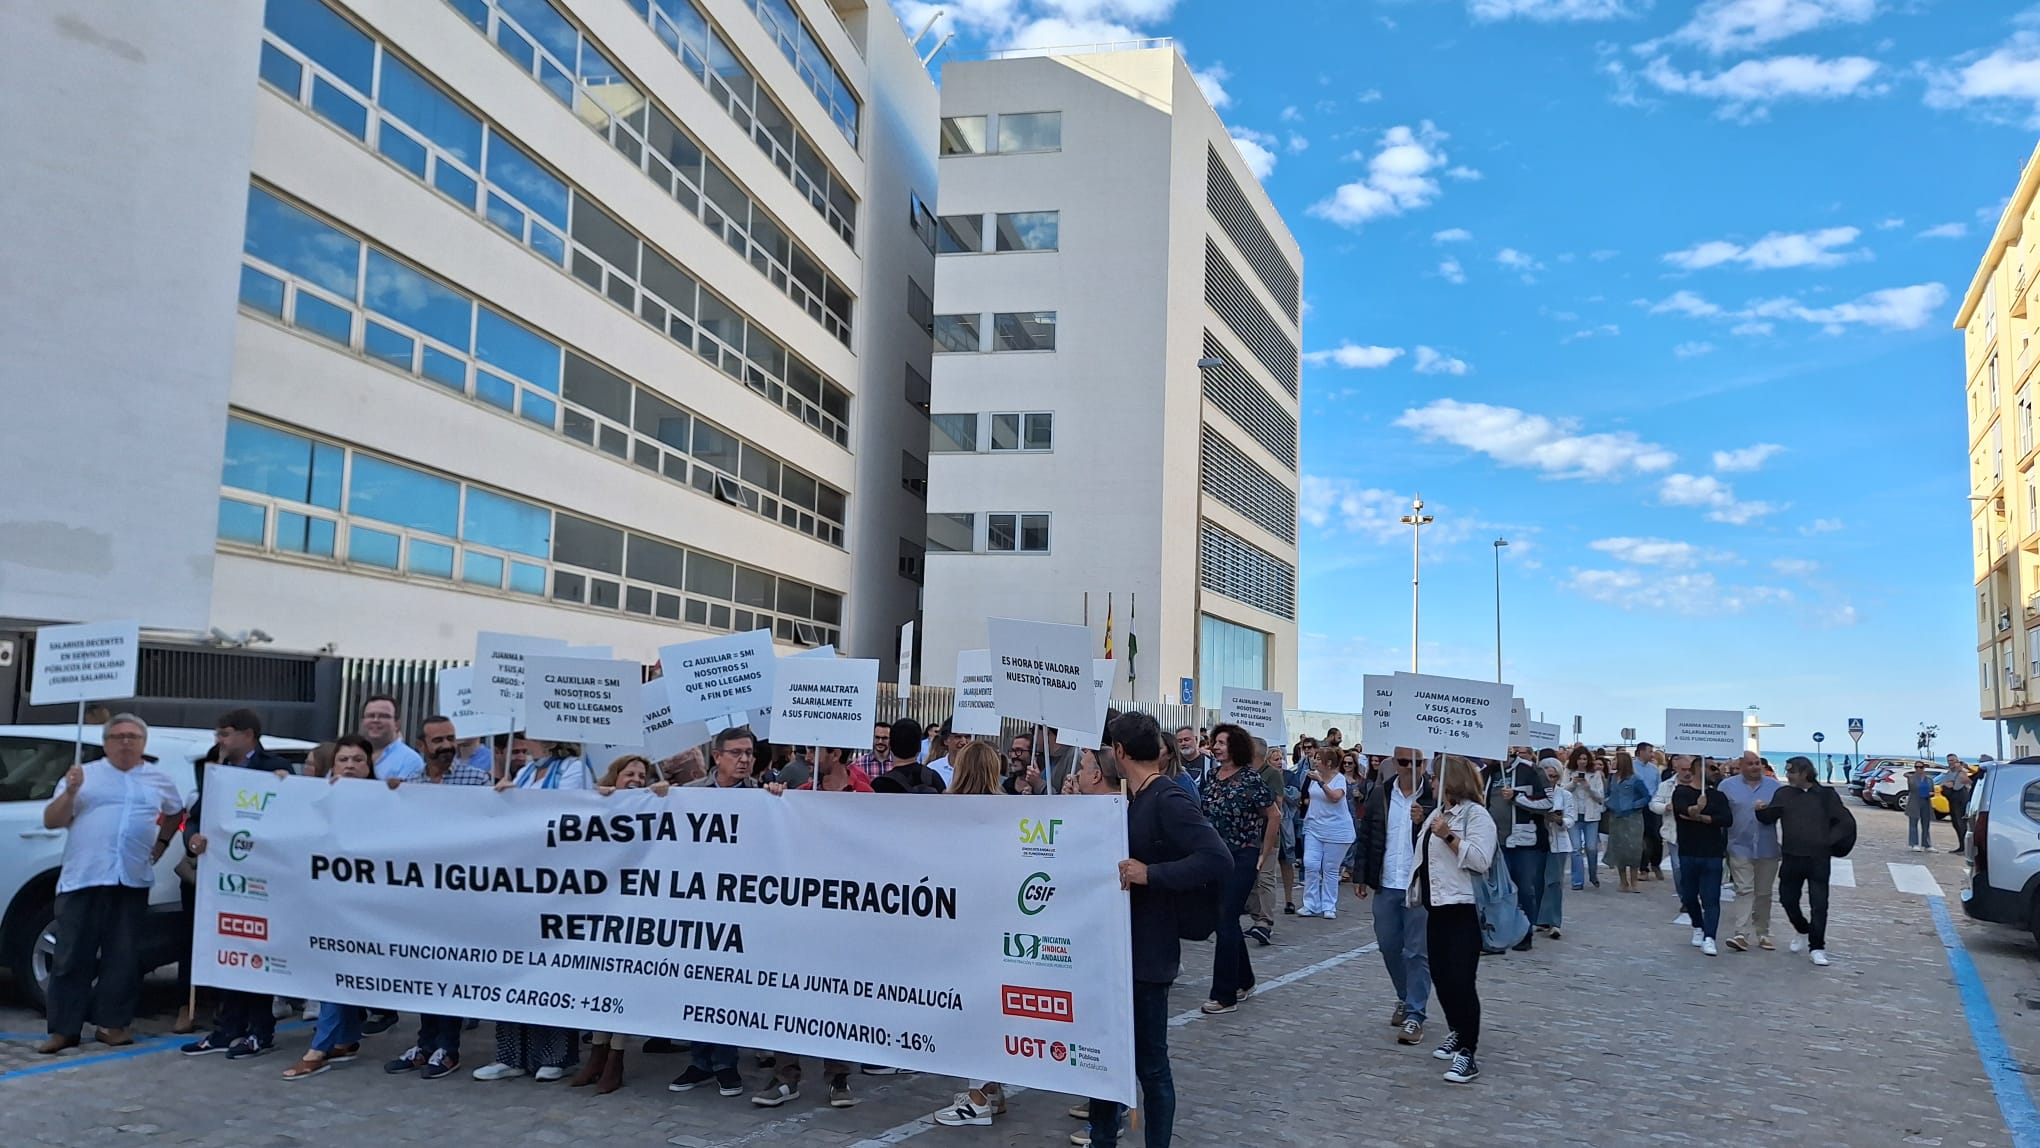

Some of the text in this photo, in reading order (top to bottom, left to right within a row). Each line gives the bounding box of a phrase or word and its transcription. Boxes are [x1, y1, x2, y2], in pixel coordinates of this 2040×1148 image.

[60, 652, 71, 661] EN
[682, 660, 694, 668] C2
[695, 653, 732, 666] AUXILIAR
[739, 649, 755, 658] SMI
[504, 665, 516, 673] SUS
[694, 662, 749, 678] NOSOTROS SI
[1001, 656, 1080, 676] ES HORA DE VALORAR
[545, 675, 555, 683] C2
[557, 676, 596, 686] AUXILIAR
[604, 679, 620, 687] SMI
[685, 671, 762, 693] QUE NO LLEGAMOS
[789, 683, 859, 694] JUANMA MALTRATA
[1006, 671, 1077, 691] NUESTRO TRABAJO
[554, 688, 611, 700] NOSOTROS SI
[700, 685, 752, 702] A FIN DE MES
[792, 696, 853, 707] SALARIALMENTE
[1414, 691, 1490, 706] JUANMA MORENO
[544, 700, 623, 713] QUE NO LLEGAMOS
[1424, 703, 1477, 717] Y SUS ALTOS
[556, 714, 611, 725] A FIN DE MES
[782, 709, 787, 718] A
[788, 709, 802, 718] SUS
[803, 710, 862, 721] FUNCIONARIOS
[1416, 713, 1454, 725] CARGOS:
[1463, 719, 1473, 728] 18
[1474, 721, 1484, 729] %
[645, 718, 674, 734] TRABA
[1427, 726, 1442, 735] TÚ:
[1449, 729, 1460, 737] 16
[1460, 730, 1470, 738] %
[546, 811, 739, 848] ¡BASTA YA!
[311, 854, 957, 920] POR LA IGUALDAD EN LA RECUPERACIÓN
[220, 917, 265, 936] CCOO
[540, 913, 745, 954] RETRIBUTIVA
[1041, 935, 1072, 945] INICIATIVA
[1041, 944, 1067, 954] SINDICAL
[217, 949, 249, 968] UGT
[1040, 953, 1072, 963] ANDALUZA
[309, 935, 964, 1011] PERSONAL FUNCIONARIO DE LA ADMINISTRACIÓN GENERAL DE LA JUNTA DE ANDALUCÍA
[335, 973, 624, 1015] PRESIDENTE Y ALTOS CARGOS: +18%
[1006, 991, 1068, 1016] CCOO
[682, 1004, 936, 1053] PERSONAL FUNCIONARIO: -16%
[1005, 1034, 1046, 1059] UGT
[1078, 1045, 1101, 1055] Servicios
[1078, 1052, 1100, 1062] Públicos
